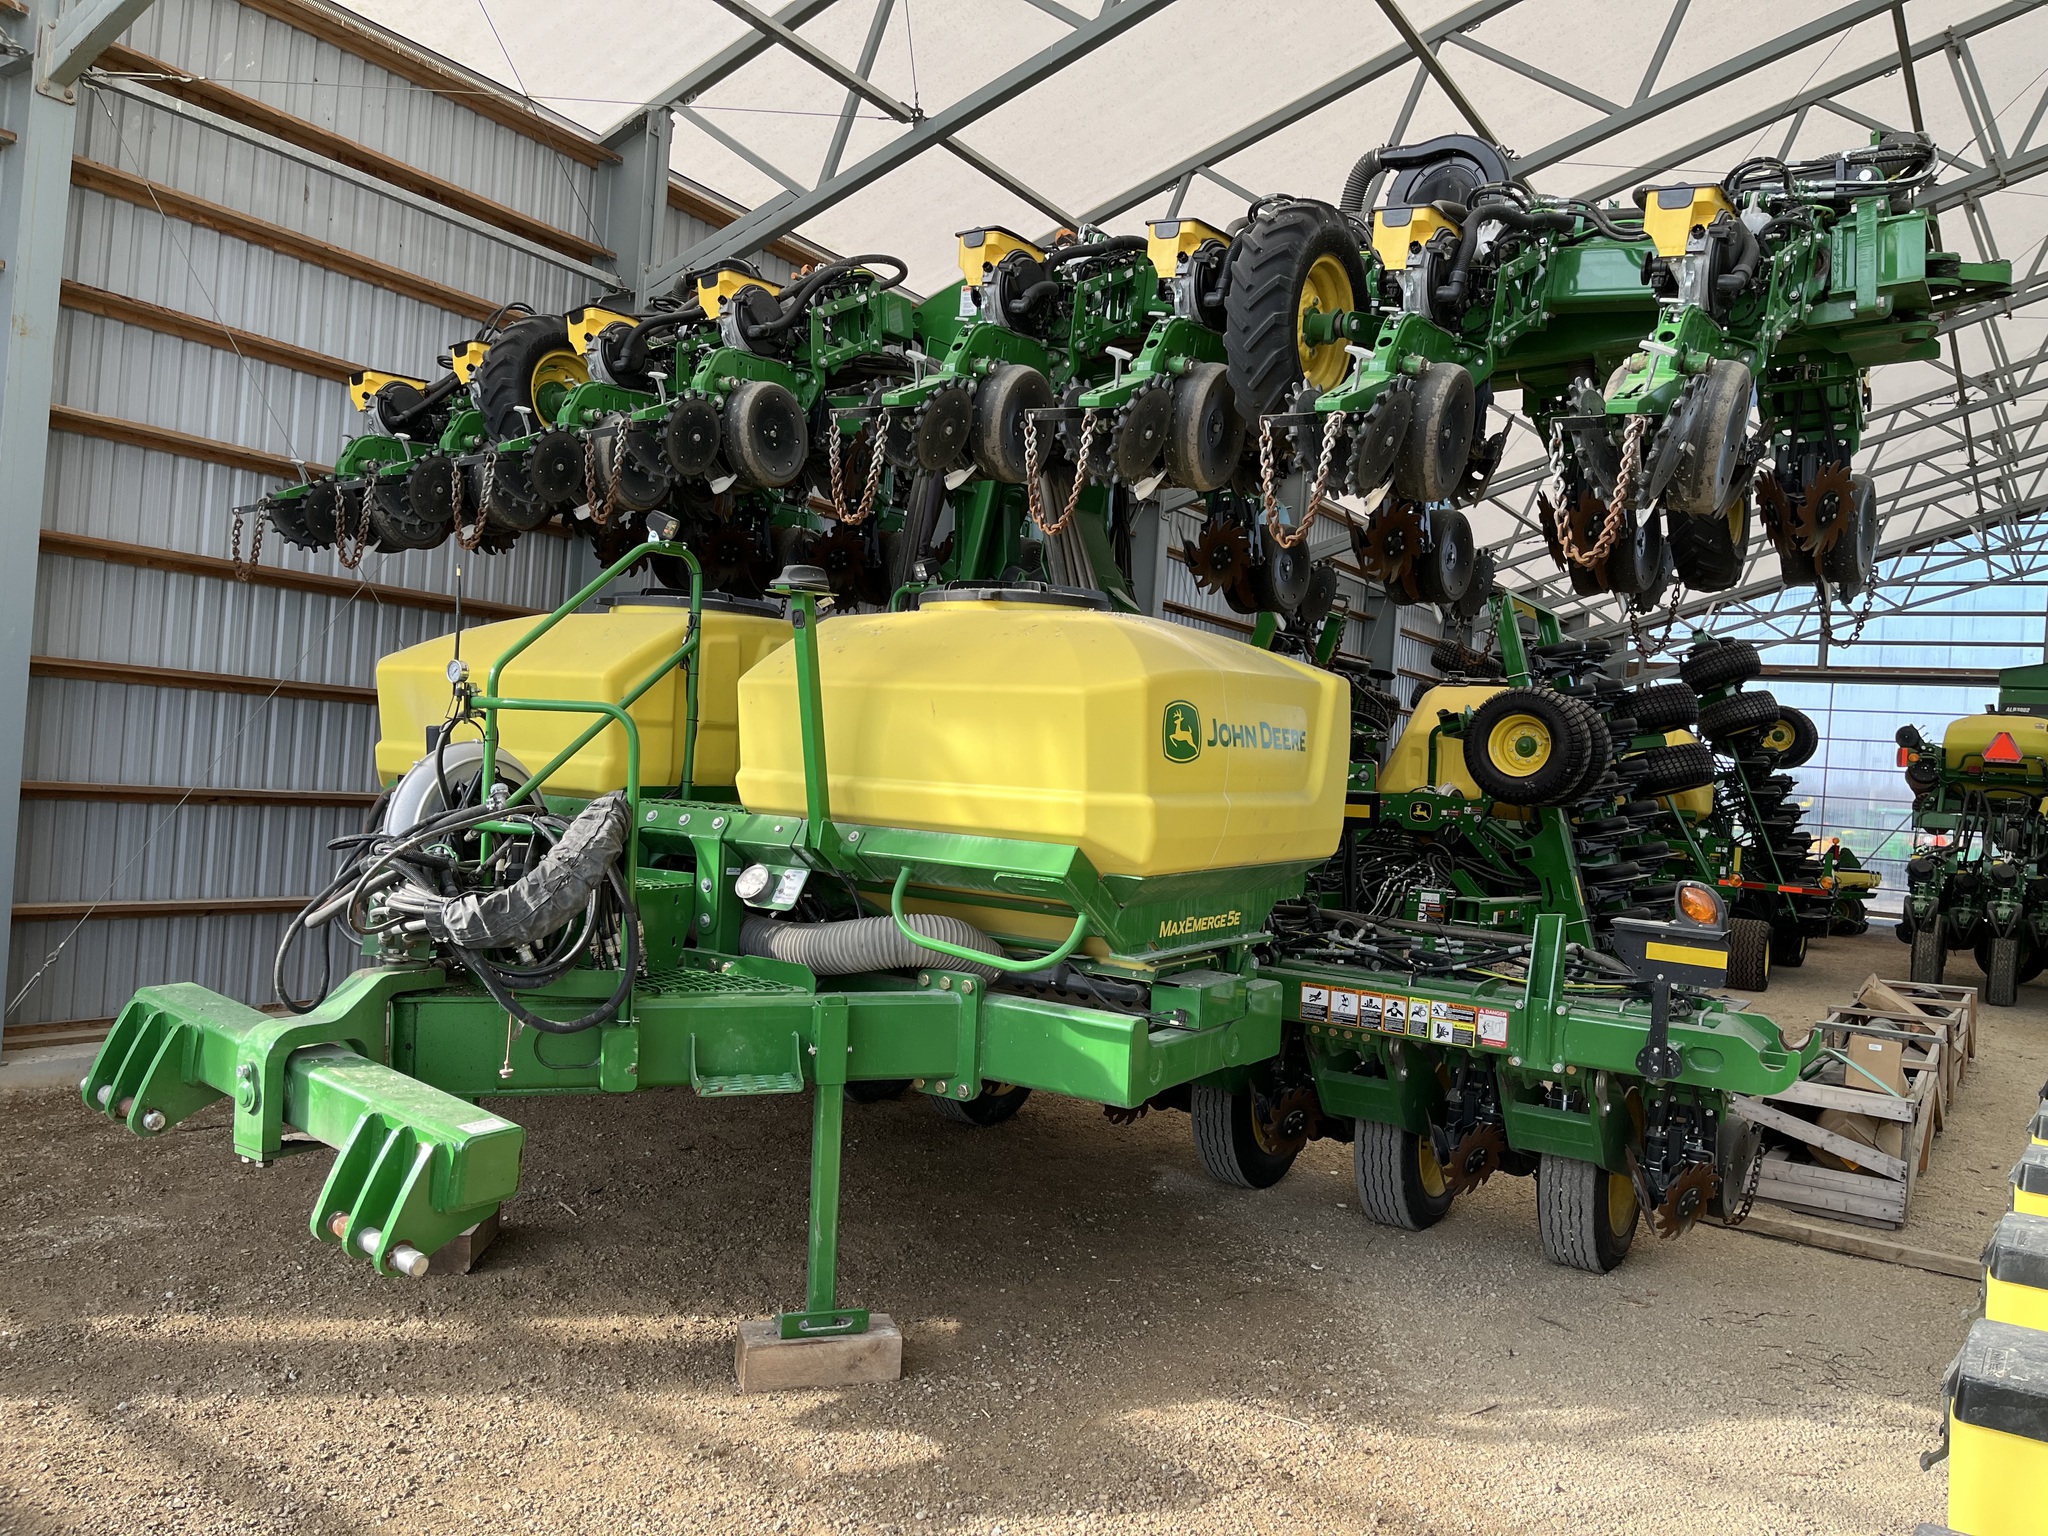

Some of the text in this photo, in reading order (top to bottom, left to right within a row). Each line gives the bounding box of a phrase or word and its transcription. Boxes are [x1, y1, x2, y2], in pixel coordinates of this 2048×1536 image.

[1207, 718, 1306, 752] JOHN DEERE
[1159, 910, 1241, 938] MAXEMERGE 5E
[1485, 1009, 1507, 1017] DANGER
